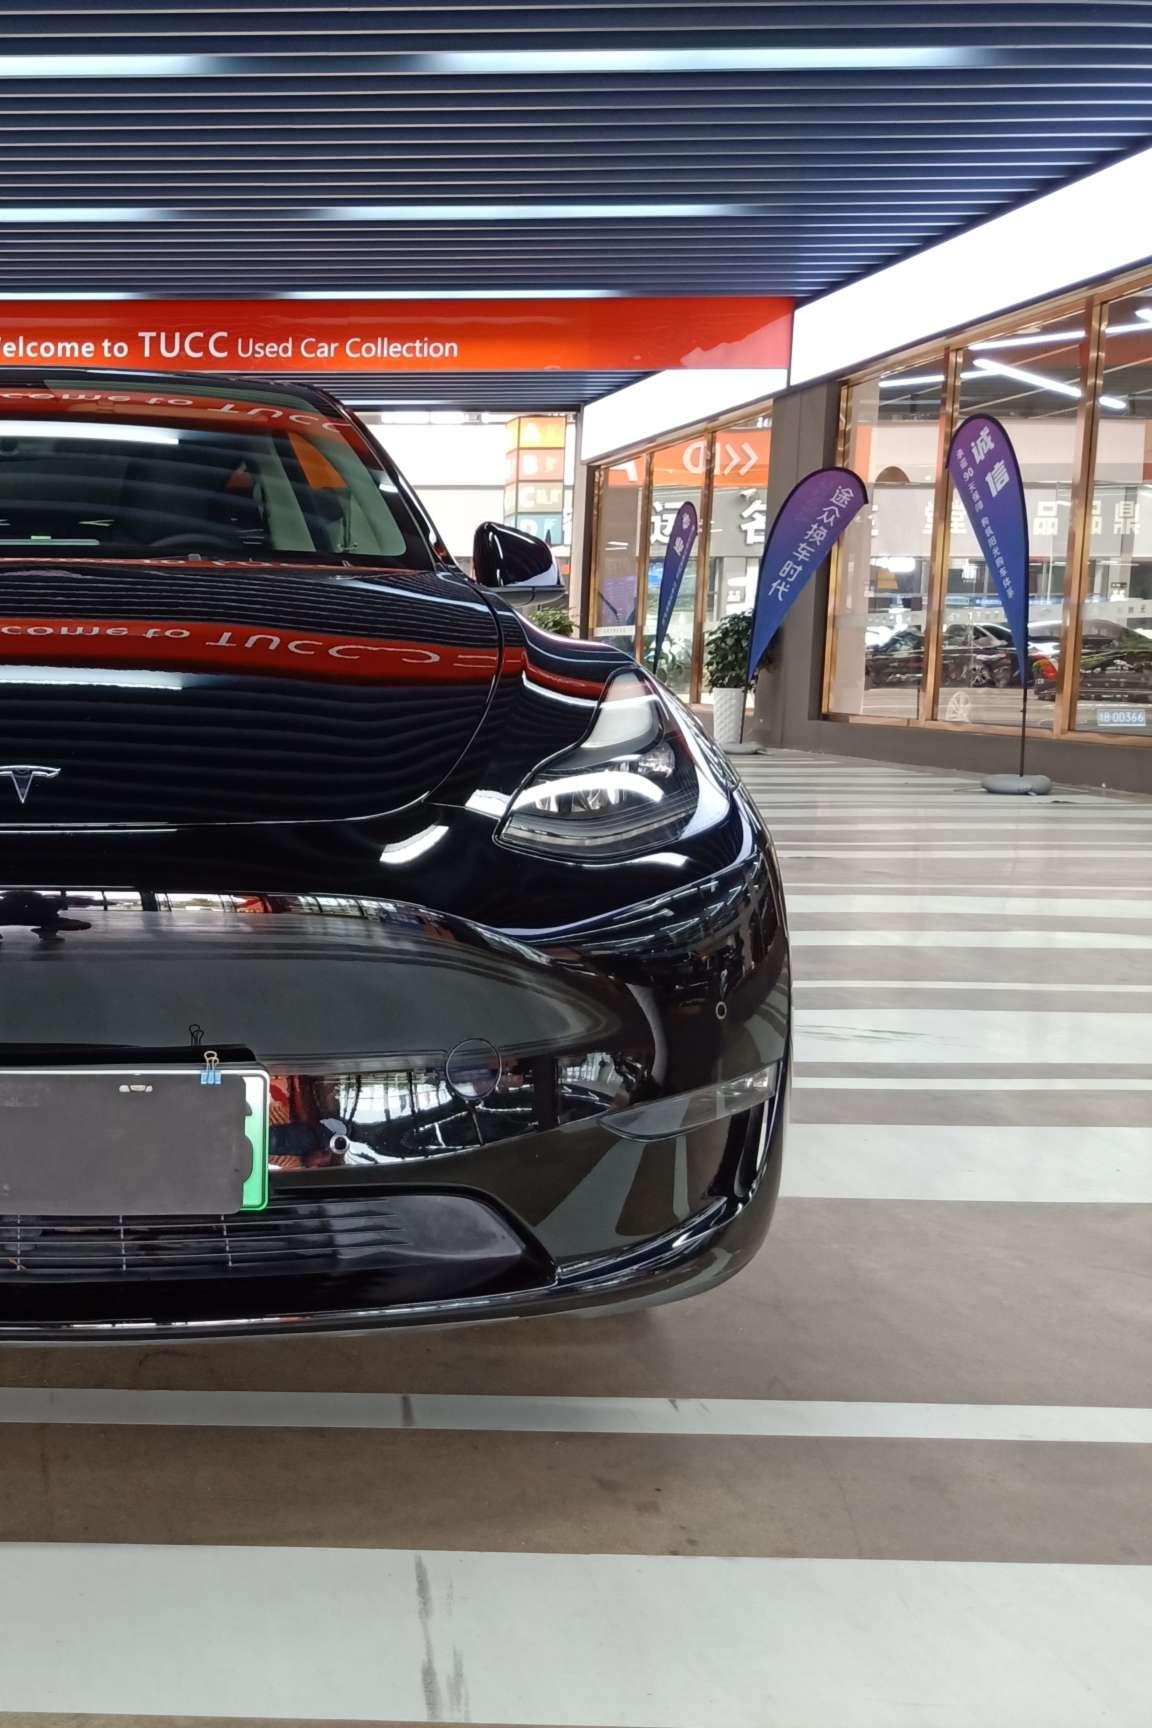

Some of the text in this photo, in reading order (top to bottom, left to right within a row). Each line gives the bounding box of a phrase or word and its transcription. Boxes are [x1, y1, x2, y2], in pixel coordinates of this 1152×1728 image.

[102, 337, 129, 358] to
[137, 331, 229, 358] TUCC
[237, 337, 293, 358] Used
[300, 337, 339, 358] Car
[345, 337, 459, 358] Collection
[971, 425, 1010, 498] 诚信
